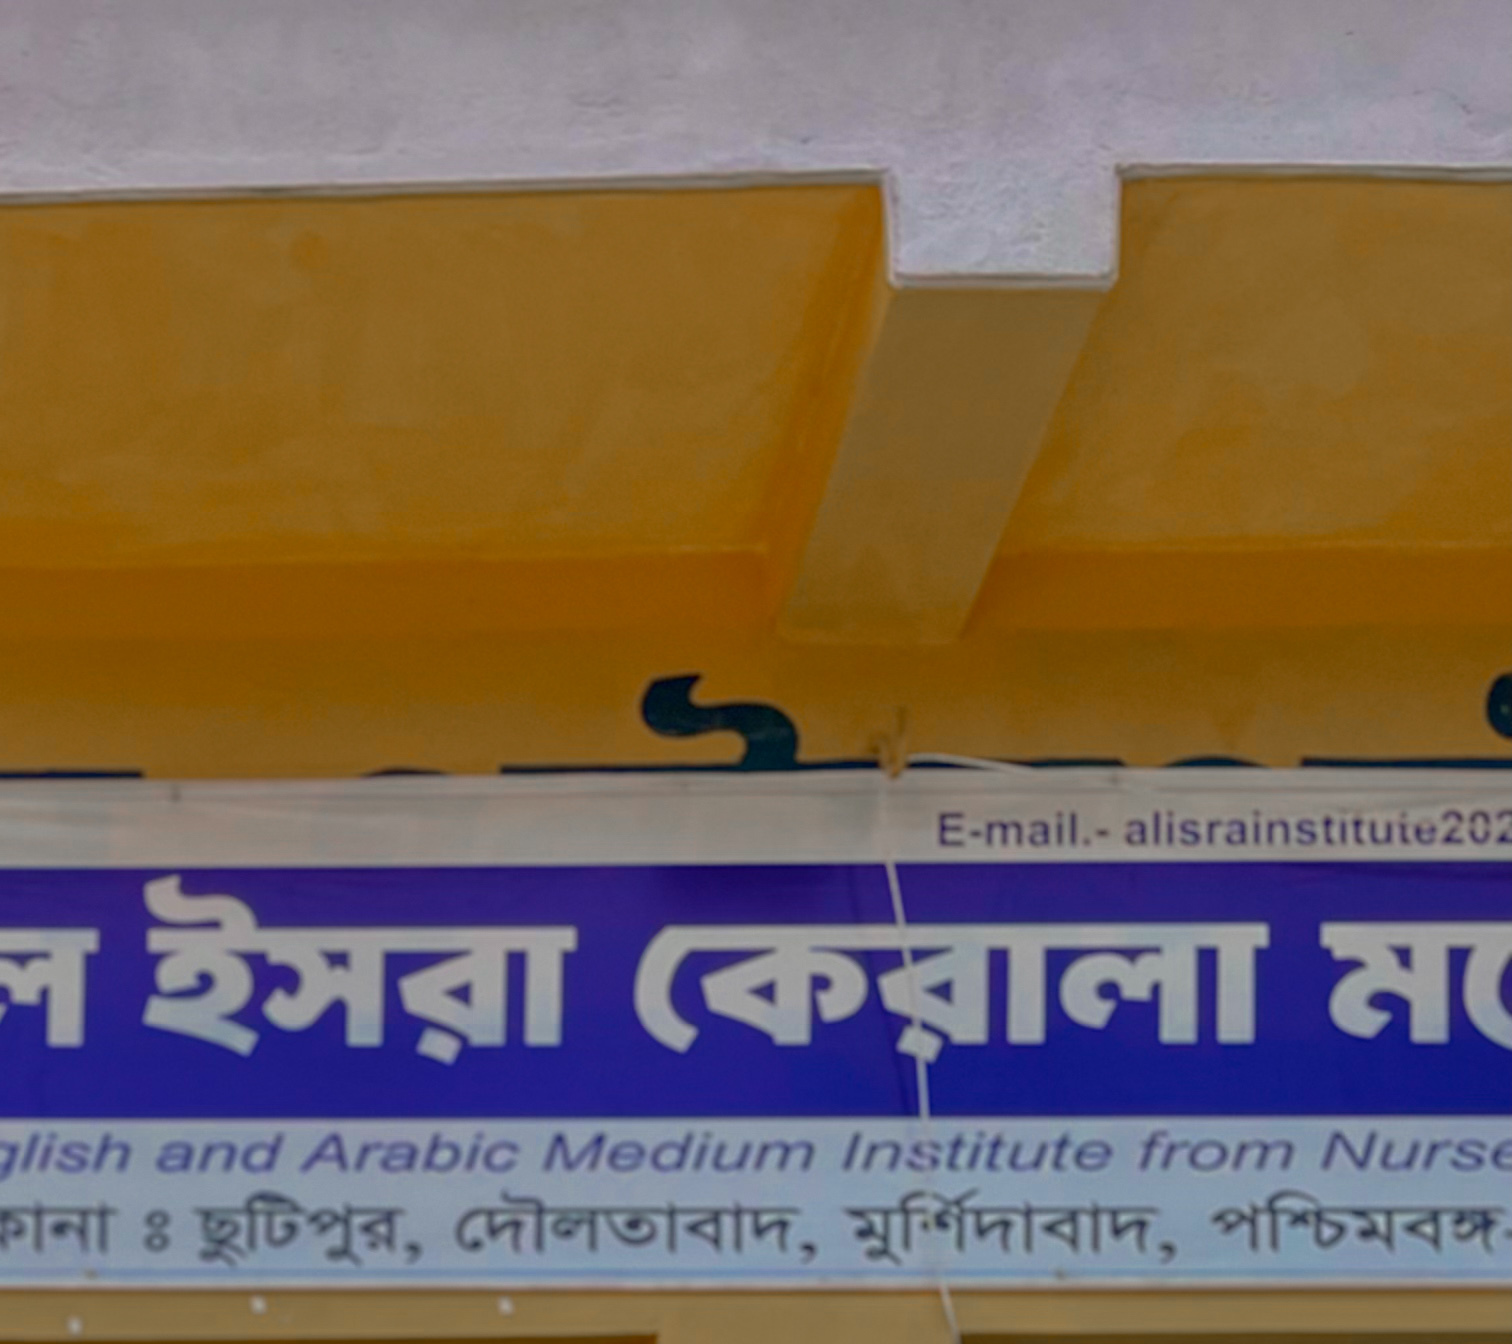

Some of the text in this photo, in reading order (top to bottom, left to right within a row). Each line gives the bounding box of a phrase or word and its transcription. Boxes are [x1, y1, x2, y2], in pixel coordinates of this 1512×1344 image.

[142, 874, 578, 1065] ইসরা
[634, 922, 1270, 1063] কেরালা
[155, 1132, 284, 1173] and
[299, 1131, 520, 1174] Arabic
[541, 1130, 816, 1173] Medium
[841, 1131, 1114, 1173] Institute
[1138, 1129, 1296, 1172] from
[455, 1189, 817, 1263] দৌলতাবাদ,
